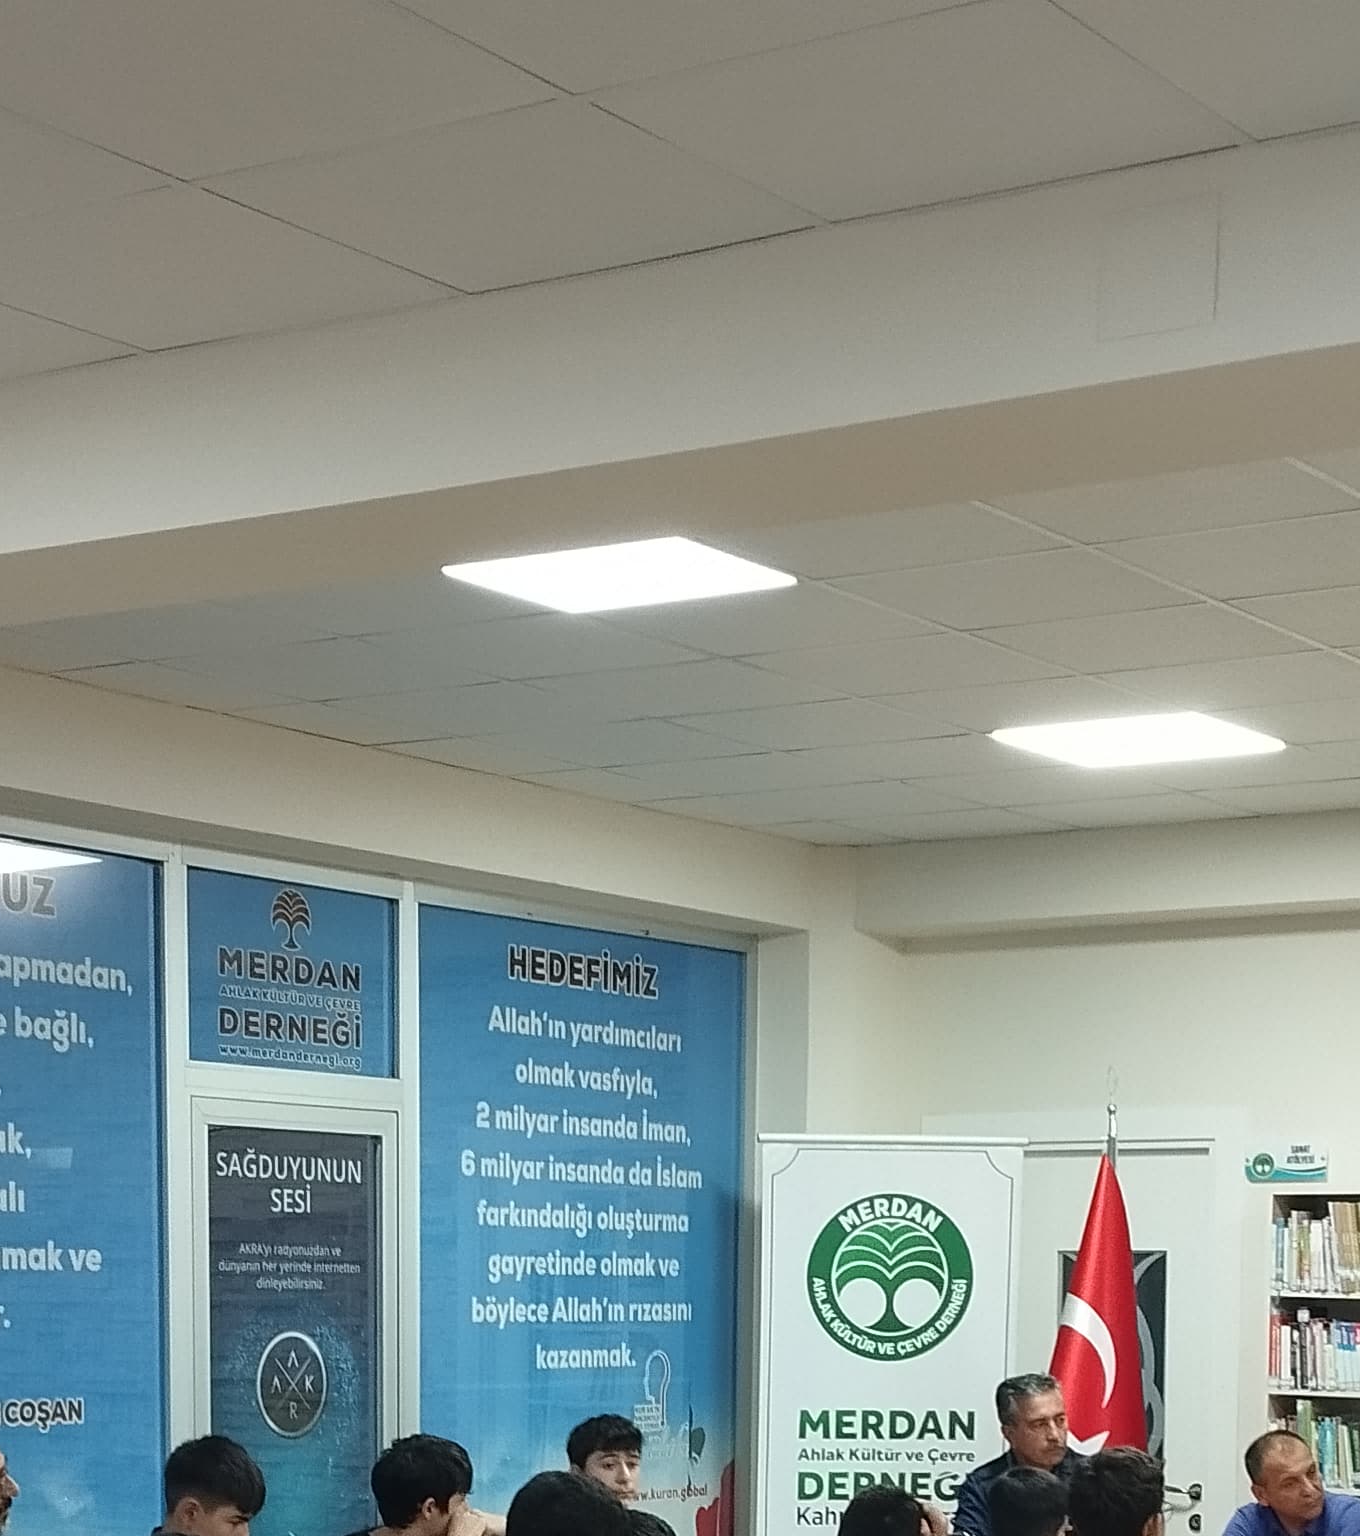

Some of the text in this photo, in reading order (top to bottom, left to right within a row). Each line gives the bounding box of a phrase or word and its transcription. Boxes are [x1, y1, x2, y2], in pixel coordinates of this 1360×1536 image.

[218, 945, 362, 992] MERDAN
[507, 944, 659, 1000] HEDEFİMİZ
[219, 984, 361, 1012] AHLAK KÜLTÜR VE ÇEVRE
[14, 1006, 94, 1052] bağlı,
[218, 1005, 362, 1050] DERNEĞİ
[569, 1020, 683, 1054] yardımcıları
[515, 1057, 576, 1089] olmak
[476, 1101, 691, 1147] 2 milyar insanda İman,
[216, 1147, 362, 1184] SAĞDUYUNUN
[460, 1149, 702, 1190] 6 milyar insanda da İslam
[270, 1184, 311, 1214] SESİ
[838, 1197, 944, 1233] MERDAN
[477, 1199, 689, 1239] farkındalığı oluşturma
[67, 1247, 102, 1273] ve
[488, 1250, 680, 1283] gayretinde olmak ve
[471, 1296, 548, 1329] böylece
[629, 1303, 693, 1323] rızasını
[812, 1277, 968, 1356] AHLAK KÜLTÜR VE ÇEVRE DERNEĞİ
[536, 1344, 636, 1371] kazanmak.
[4, 1397, 85, 1433] COŞAN
[798, 1408, 976, 1440] MERDAN
[797, 1447, 976, 1465] Ahlak Kültür ve Çevre
